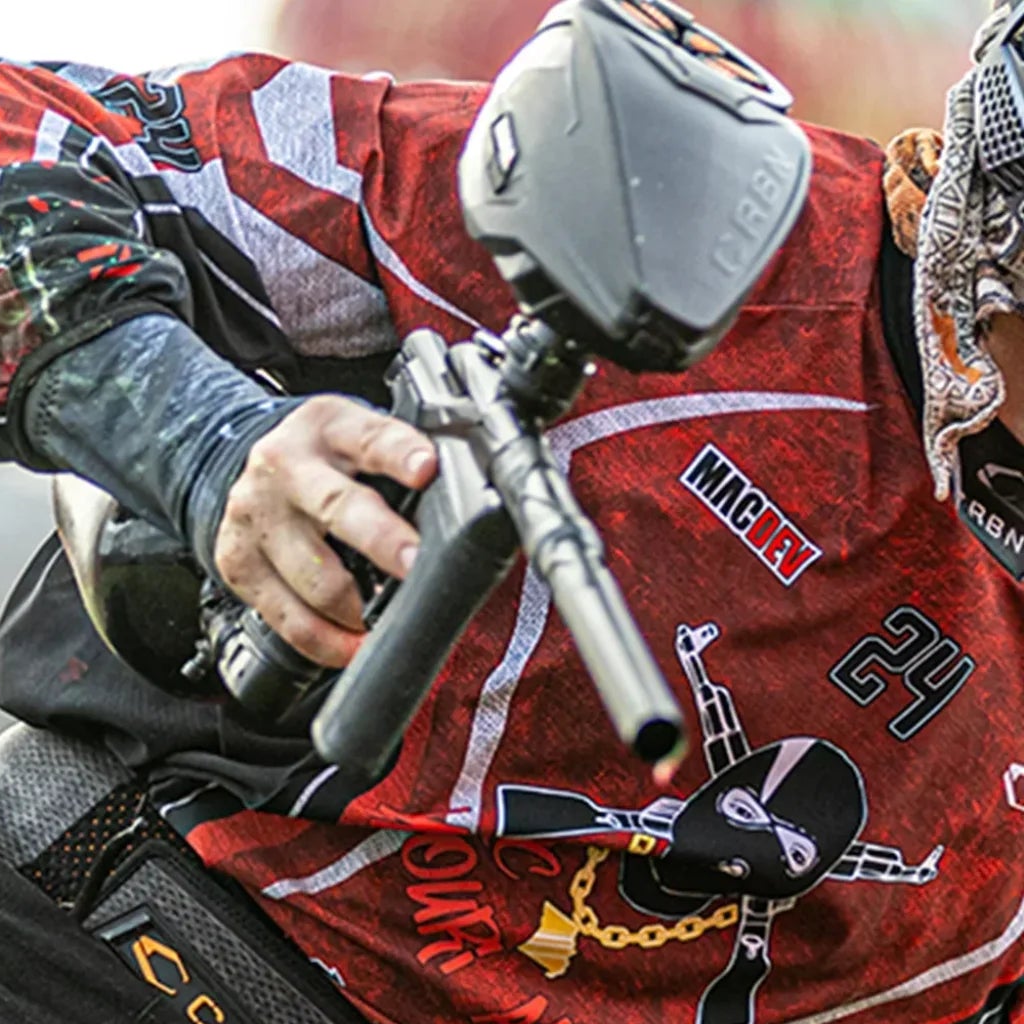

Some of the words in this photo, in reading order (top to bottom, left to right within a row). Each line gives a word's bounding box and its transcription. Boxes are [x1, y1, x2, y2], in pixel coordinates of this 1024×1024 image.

[680, 444, 821, 583] MACDEV
[967, 501, 1024, 554] RBN
[828, 605, 976, 742] 24
